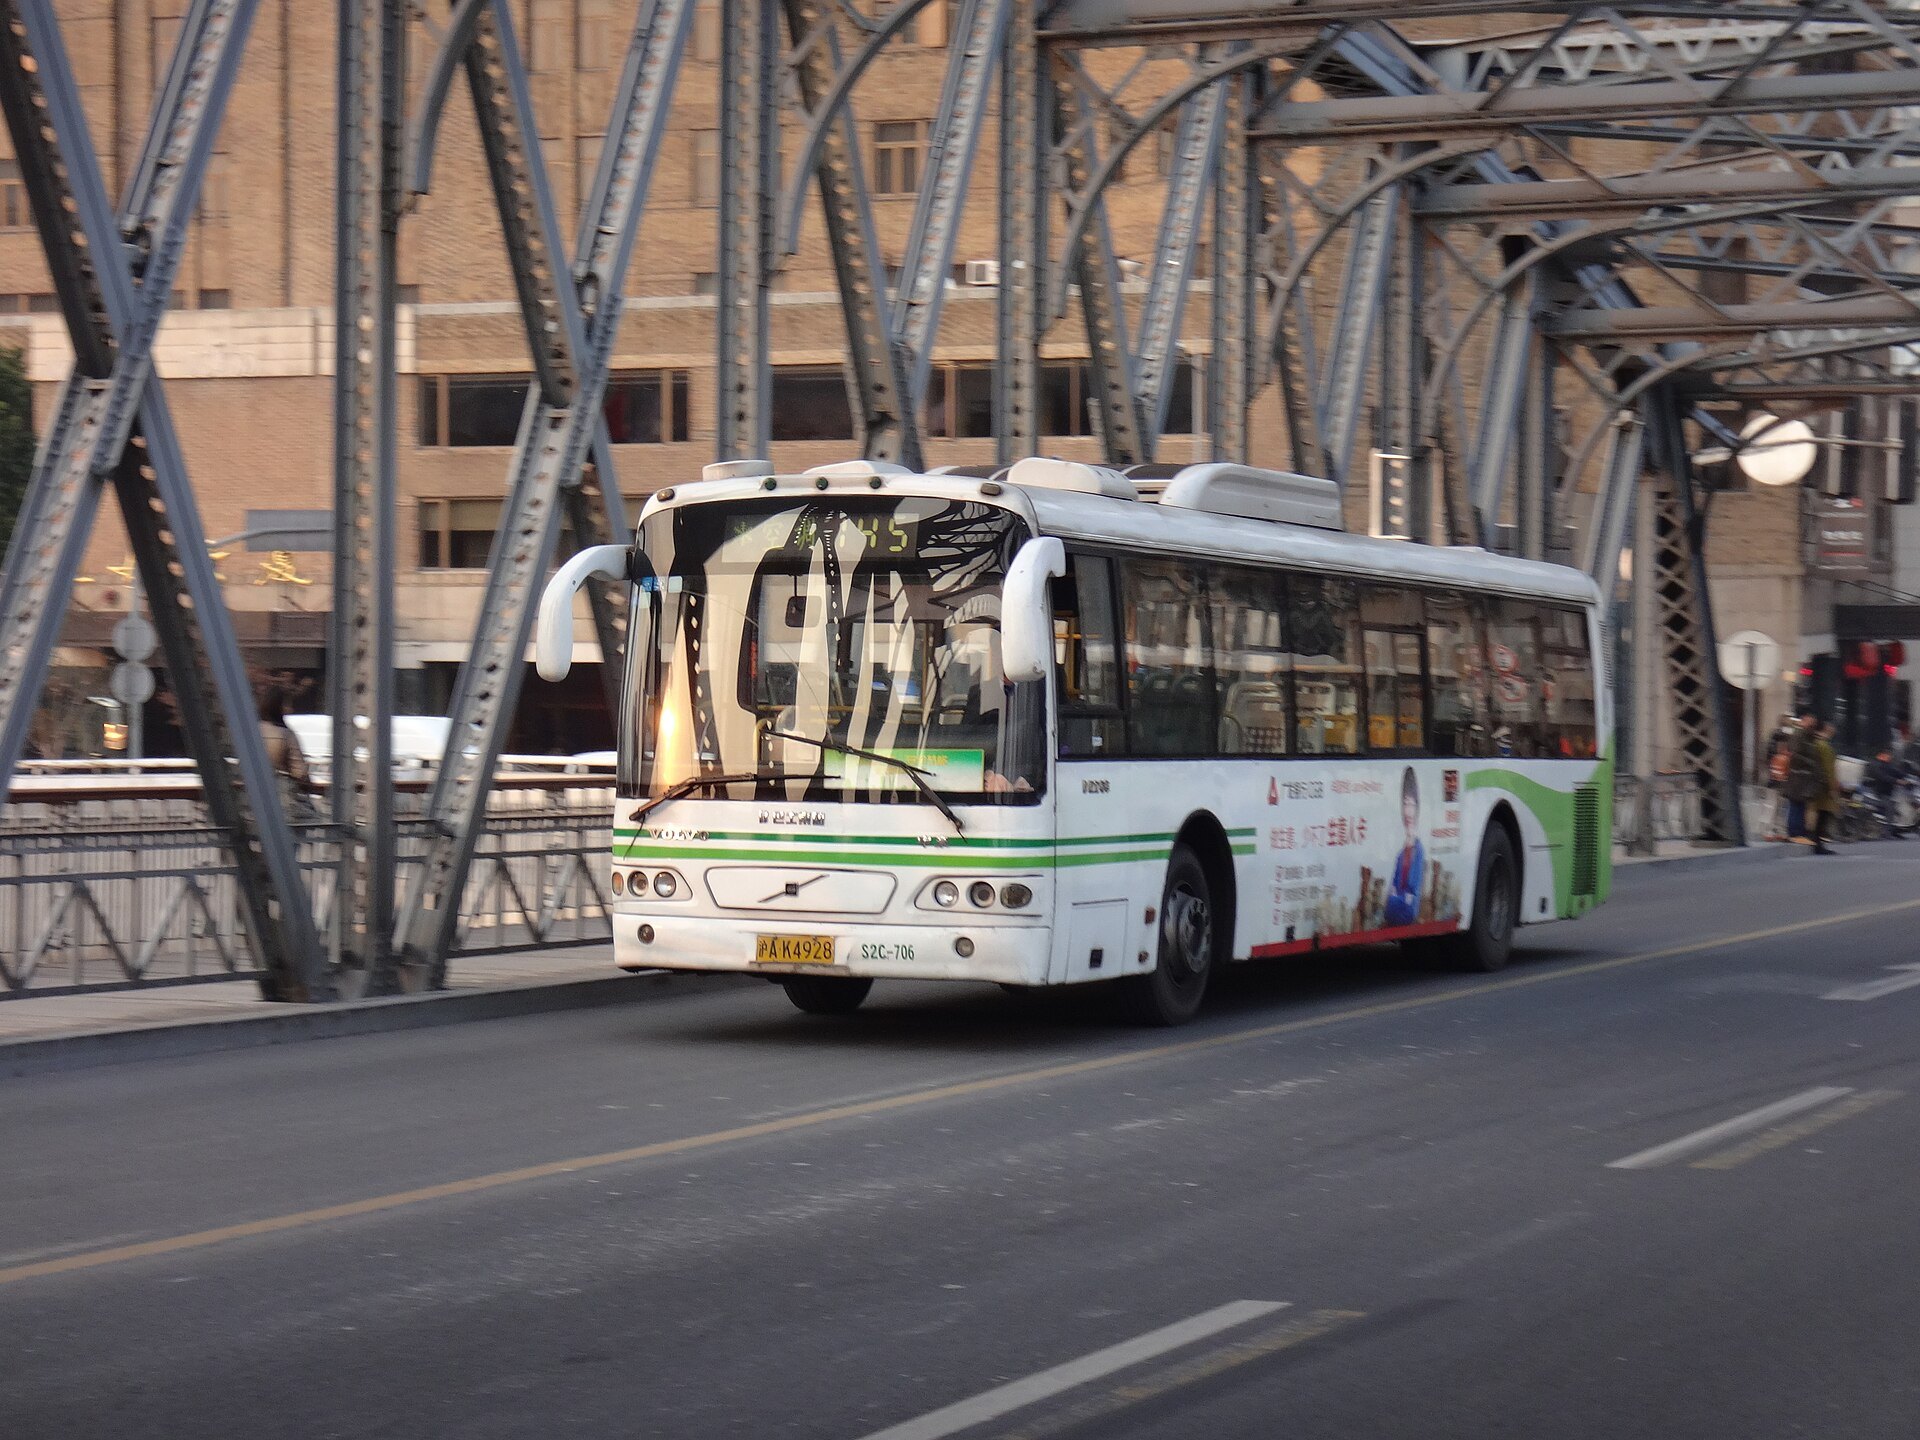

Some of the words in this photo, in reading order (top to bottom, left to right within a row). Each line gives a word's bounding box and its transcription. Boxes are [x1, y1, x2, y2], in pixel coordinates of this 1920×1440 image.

[839, 516, 908, 552] 145
[649, 828, 710, 842] VOLVO
[861, 943, 915, 961] S2C-706
